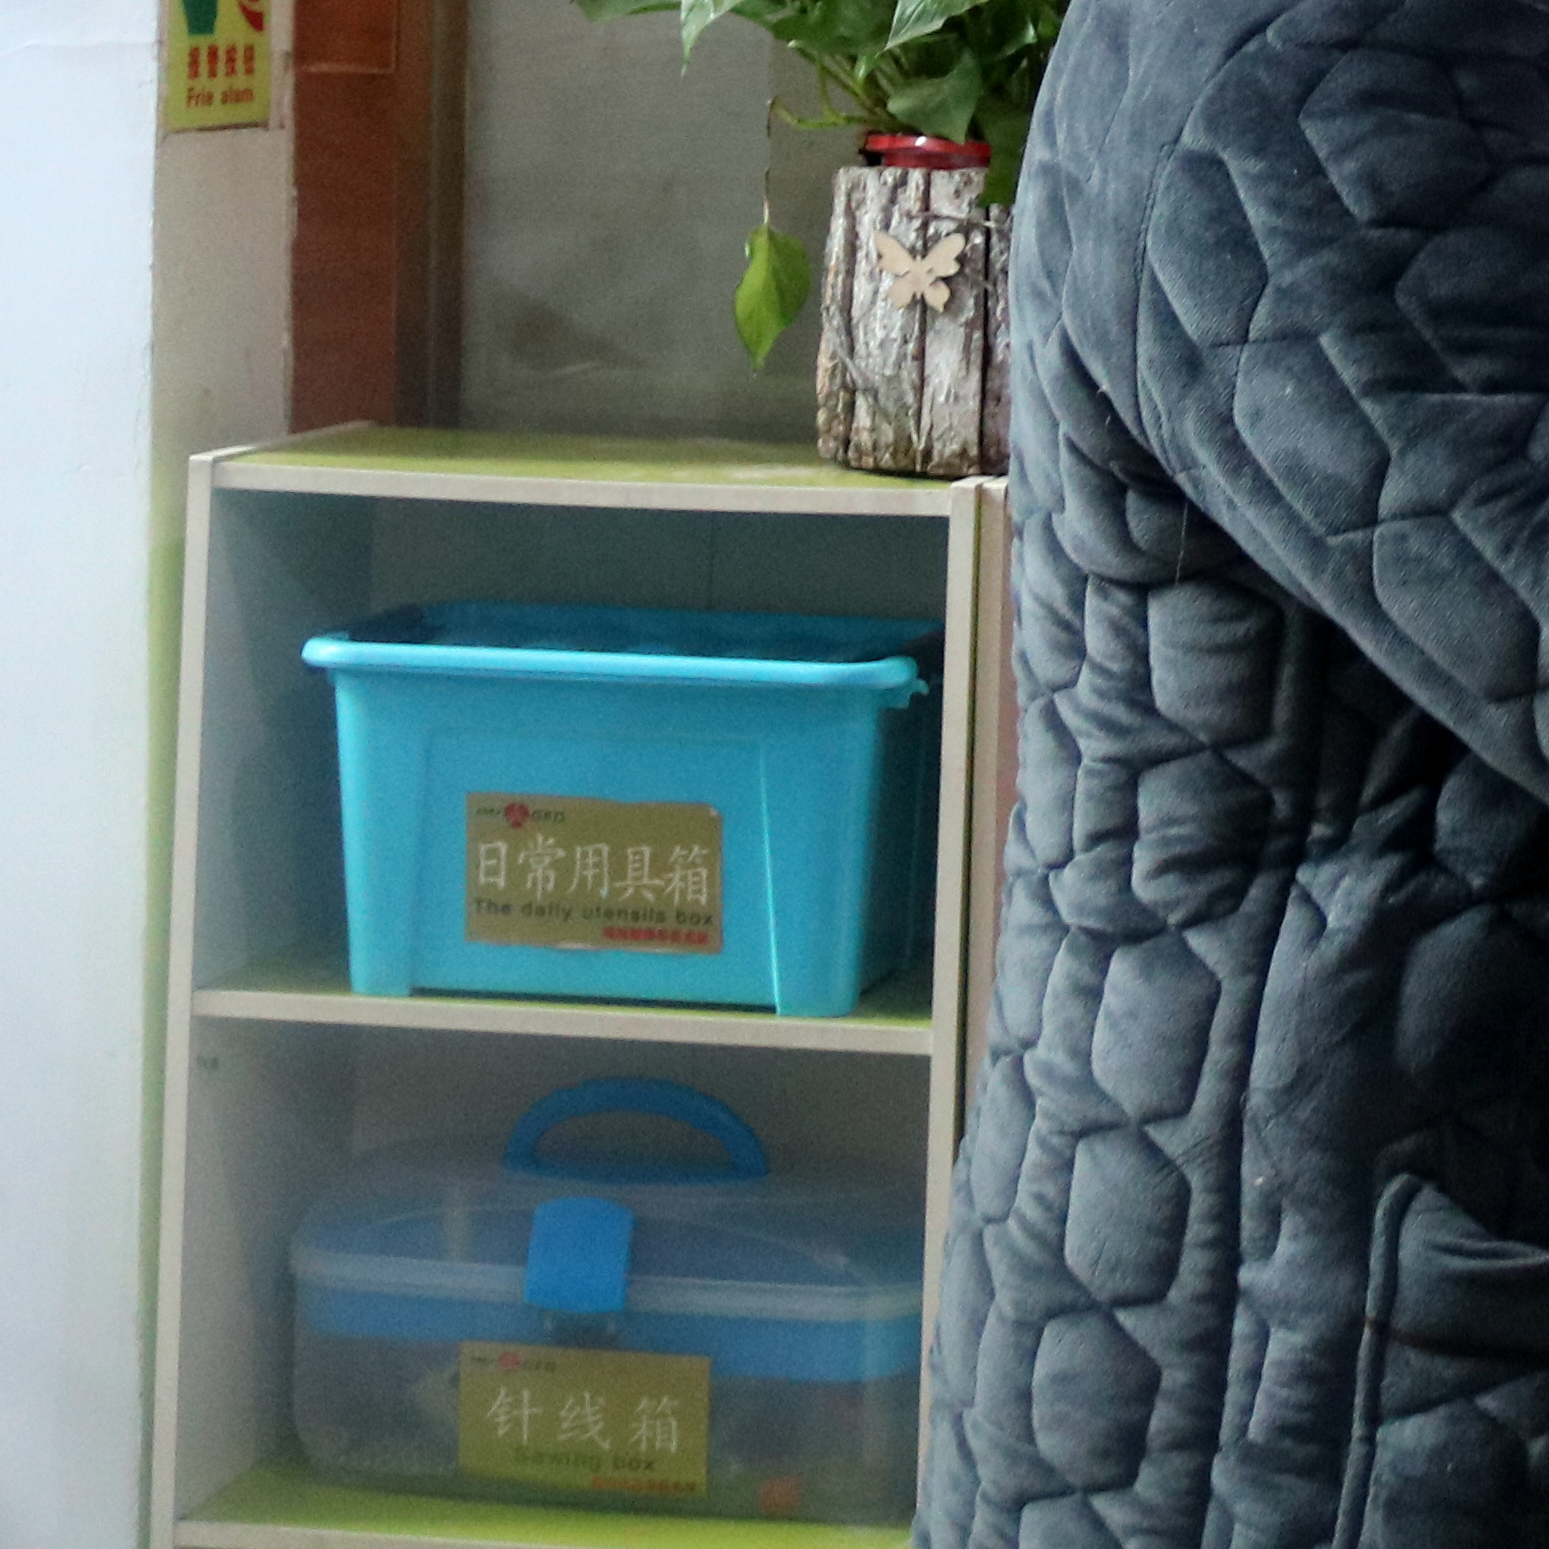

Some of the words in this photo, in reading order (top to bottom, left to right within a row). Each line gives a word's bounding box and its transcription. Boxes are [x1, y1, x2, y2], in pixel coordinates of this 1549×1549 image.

[478, 834, 709, 907] 日常用具箱
[476, 898, 512, 915] The
[520, 900, 573, 922] daily
[582, 905, 666, 924] utensils
[675, 909, 714, 925] box
[487, 1385, 680, 1455] 针线箱
[613, 1451, 655, 1472] box
